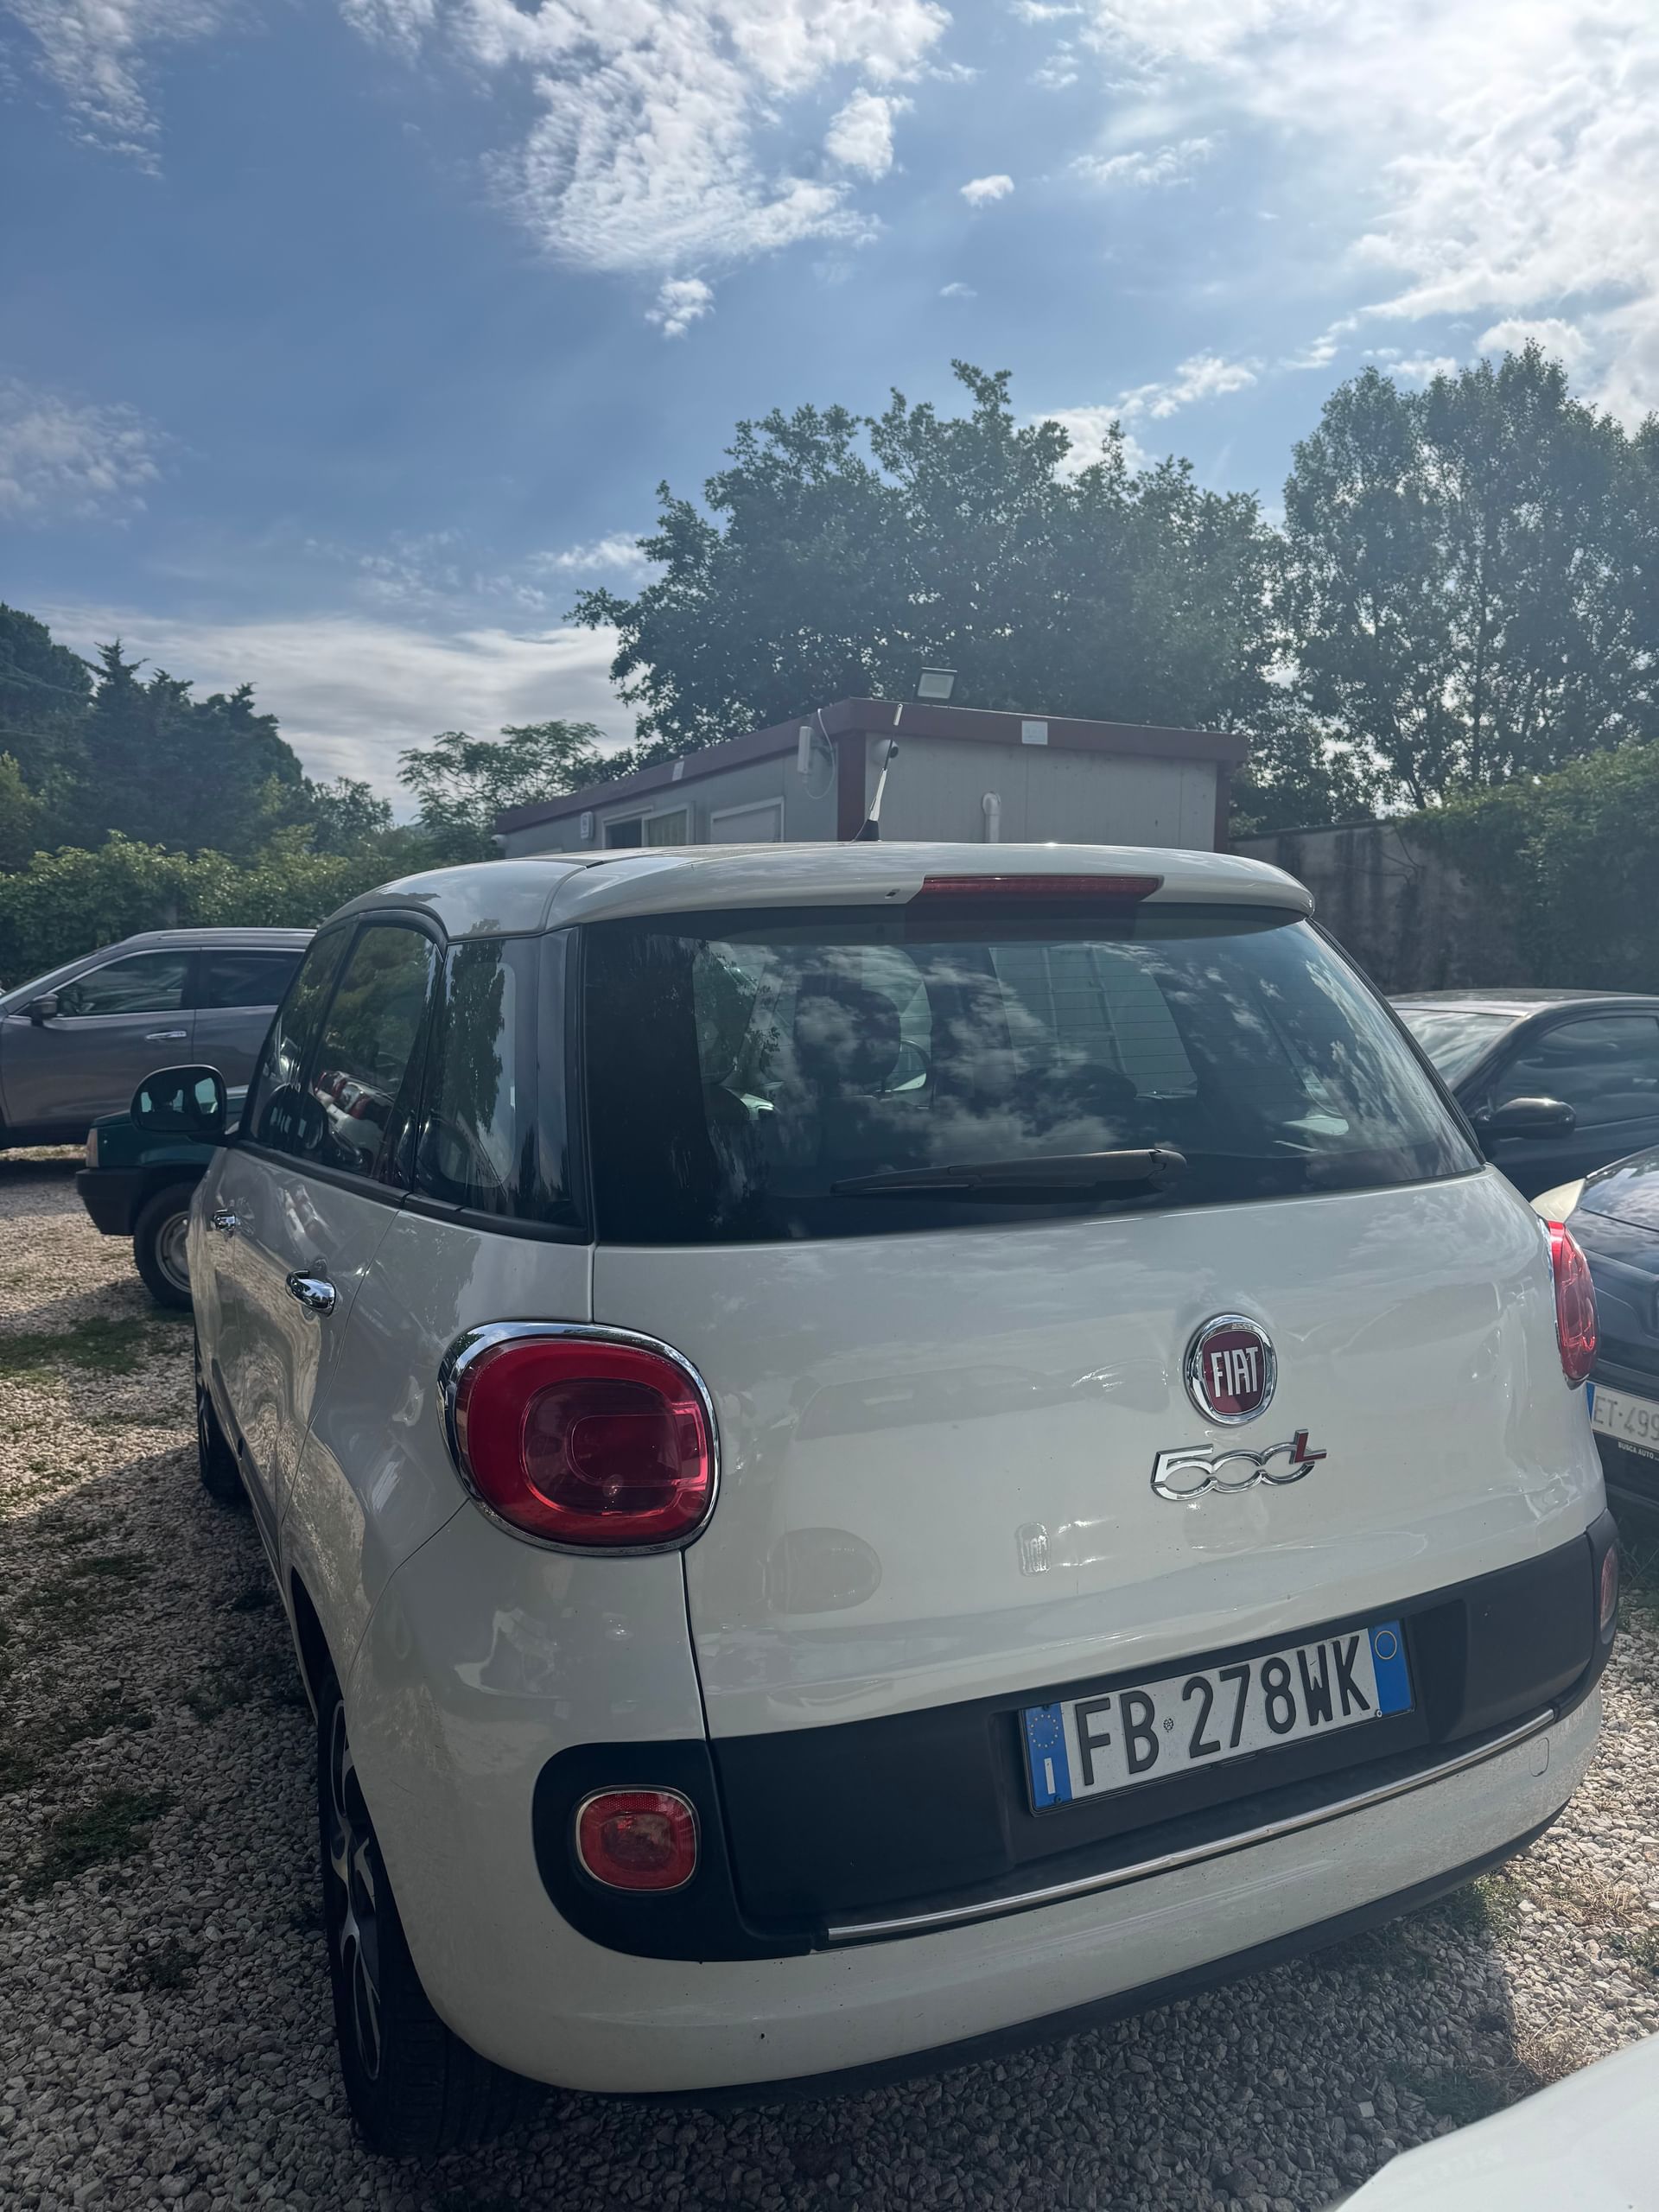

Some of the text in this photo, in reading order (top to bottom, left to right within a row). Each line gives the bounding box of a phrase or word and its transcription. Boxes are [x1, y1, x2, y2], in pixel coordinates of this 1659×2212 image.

[1211, 1346, 1259, 1398] FIAT
[1593, 1395, 1618, 1427] ET
[1150, 1428, 1328, 1501] 500L
[1637, 1448, 1654, 1459] AUTO
